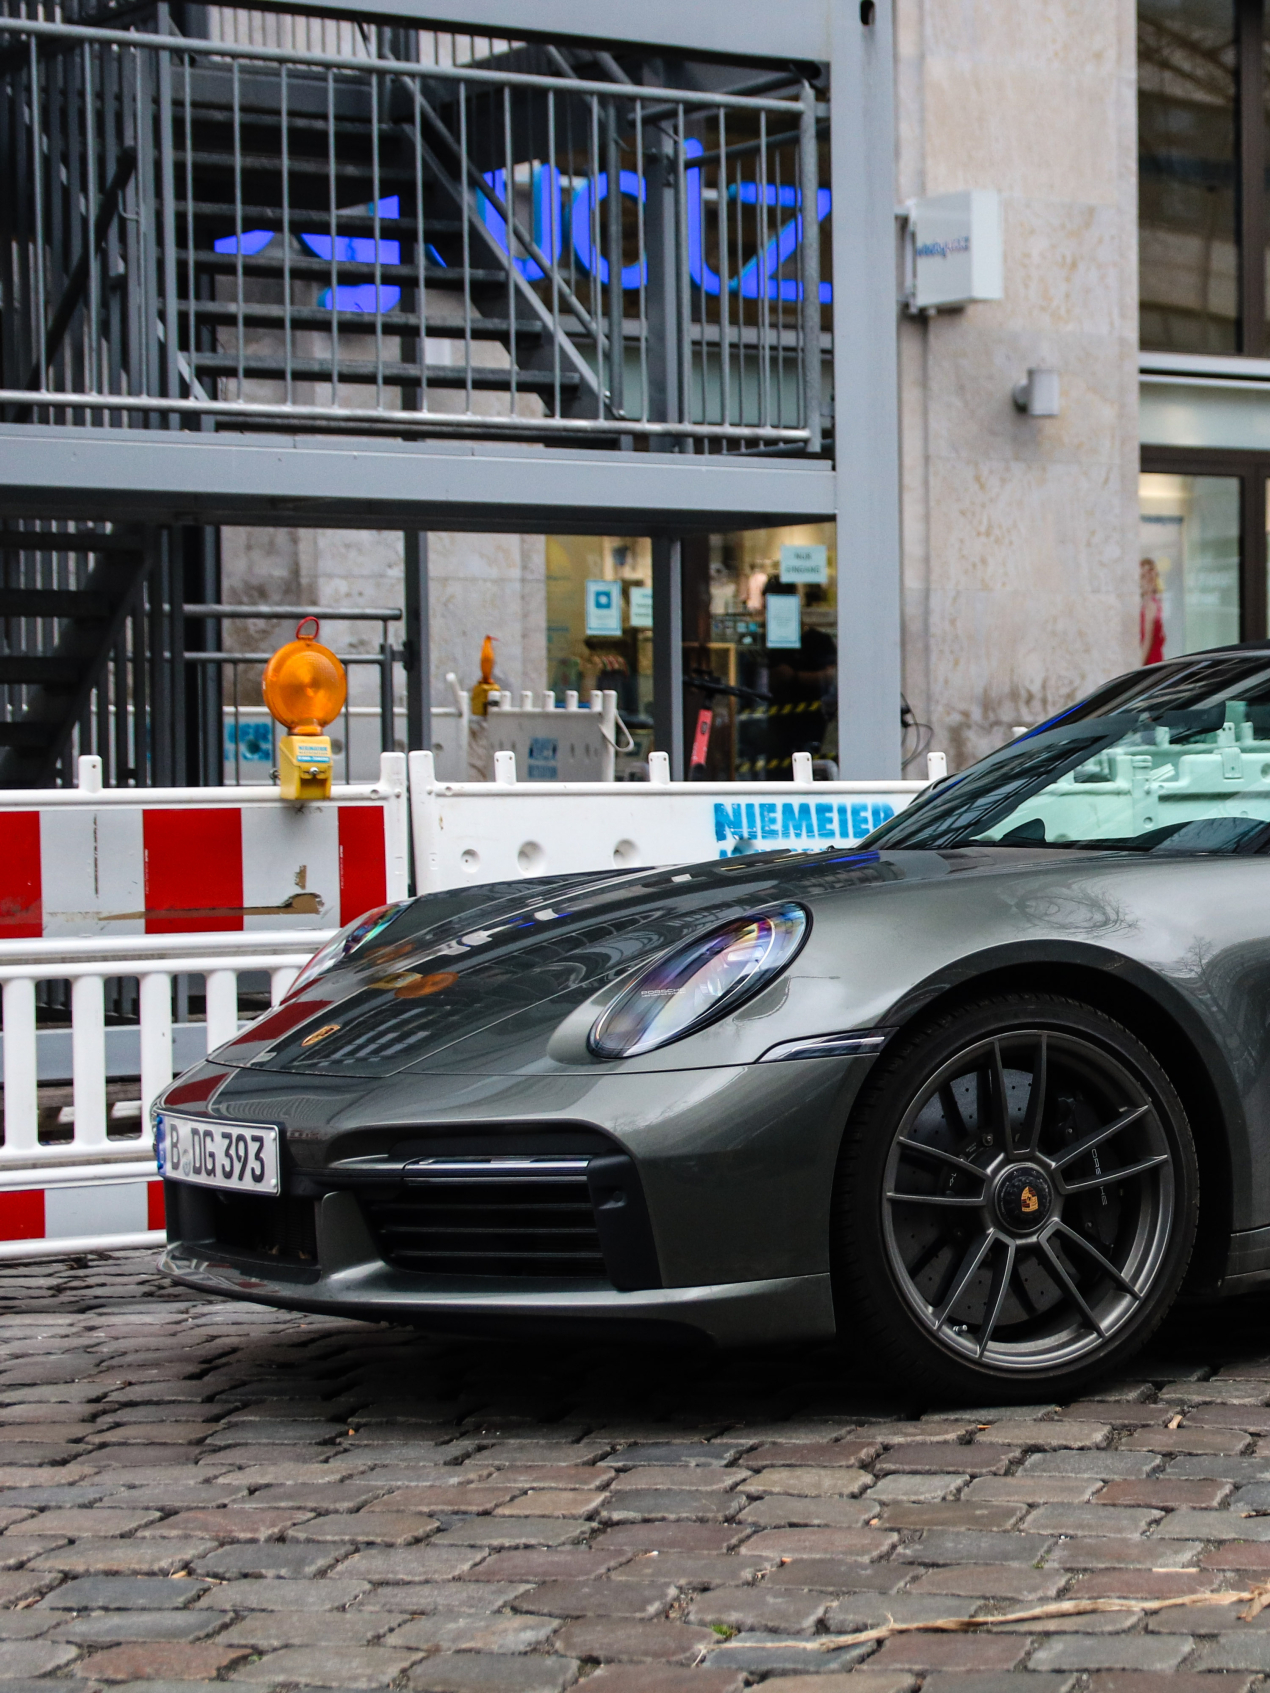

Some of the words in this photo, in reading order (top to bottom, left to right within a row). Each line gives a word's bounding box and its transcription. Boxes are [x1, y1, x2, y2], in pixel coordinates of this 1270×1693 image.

[170, 1123, 181, 1171] B
[191, 1127, 216, 1178] DG
[221, 1131, 265, 1183] 393
